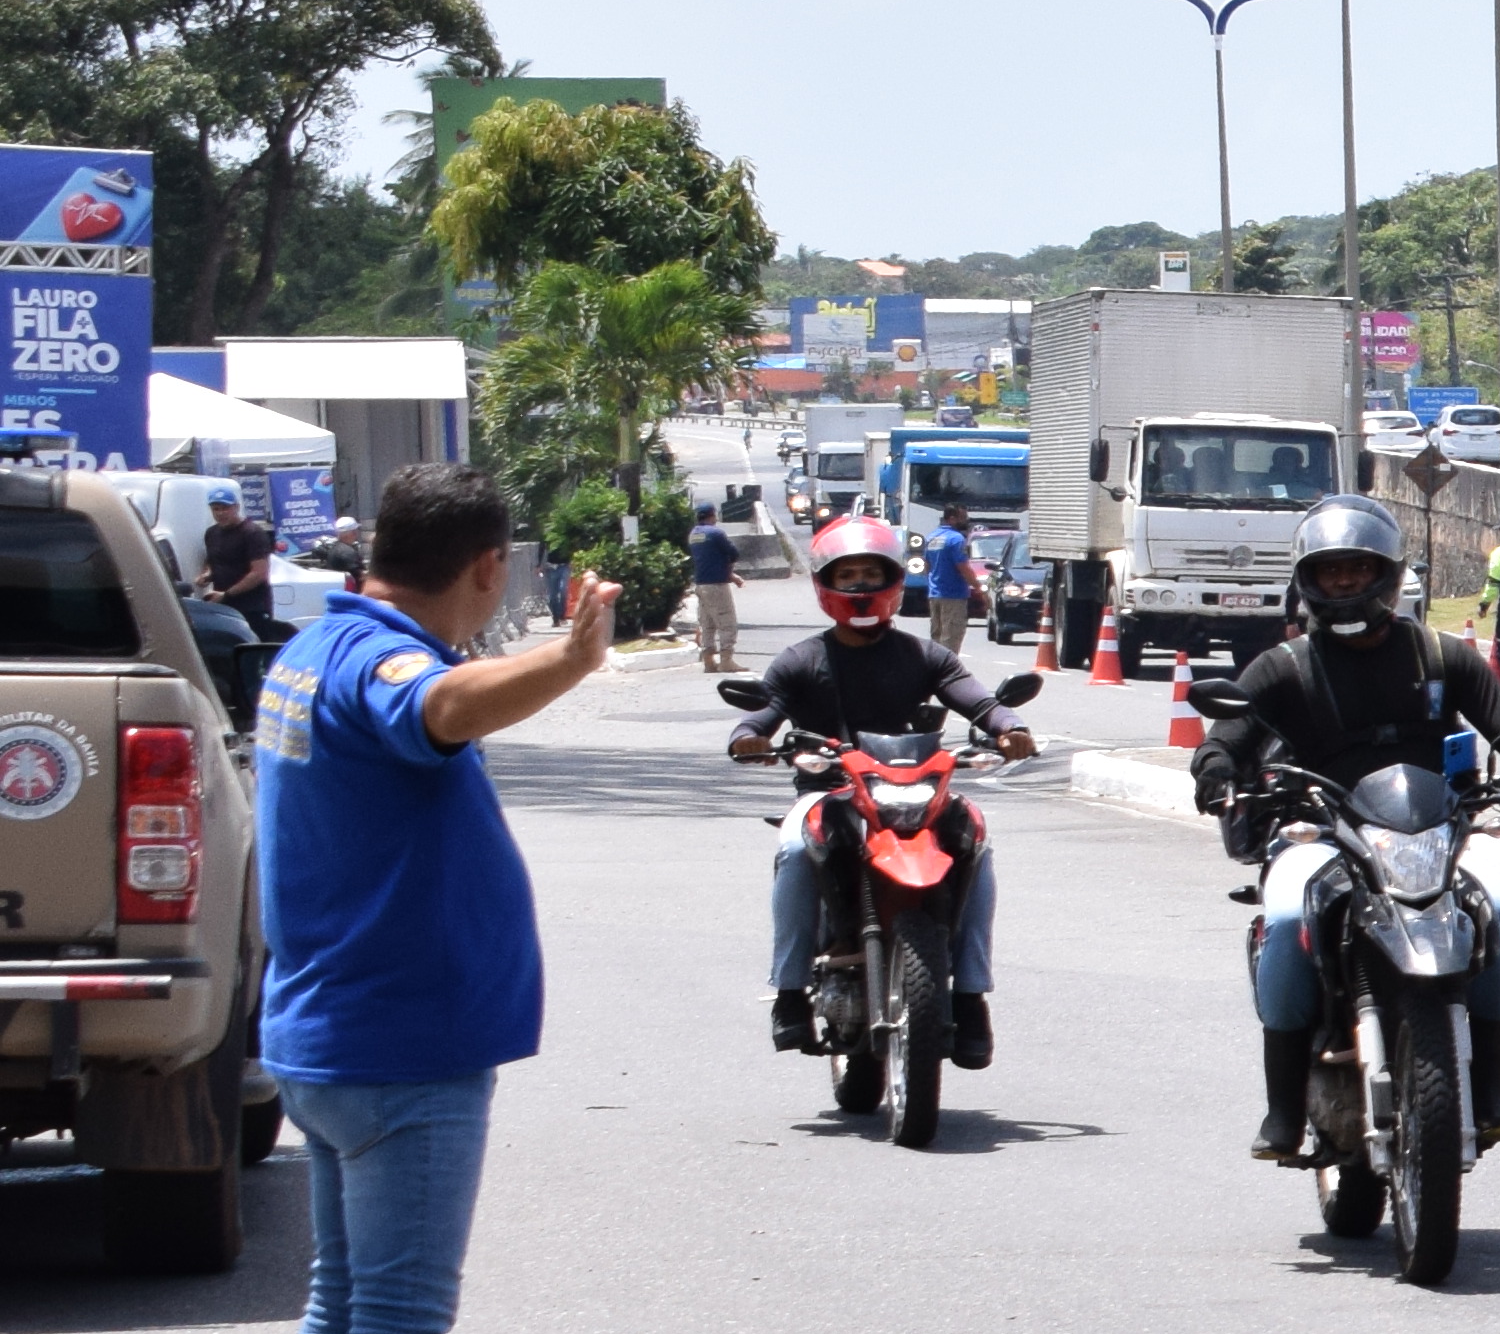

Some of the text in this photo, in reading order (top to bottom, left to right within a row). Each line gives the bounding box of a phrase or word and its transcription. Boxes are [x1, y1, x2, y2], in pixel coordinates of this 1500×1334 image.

[12, 287, 98, 309] LAURO
[12, 308, 99, 340] FILA
[13, 340, 120, 374] ZERO
[56, 719, 76, 736] DA
[75, 734, 99, 777] BAHIA
